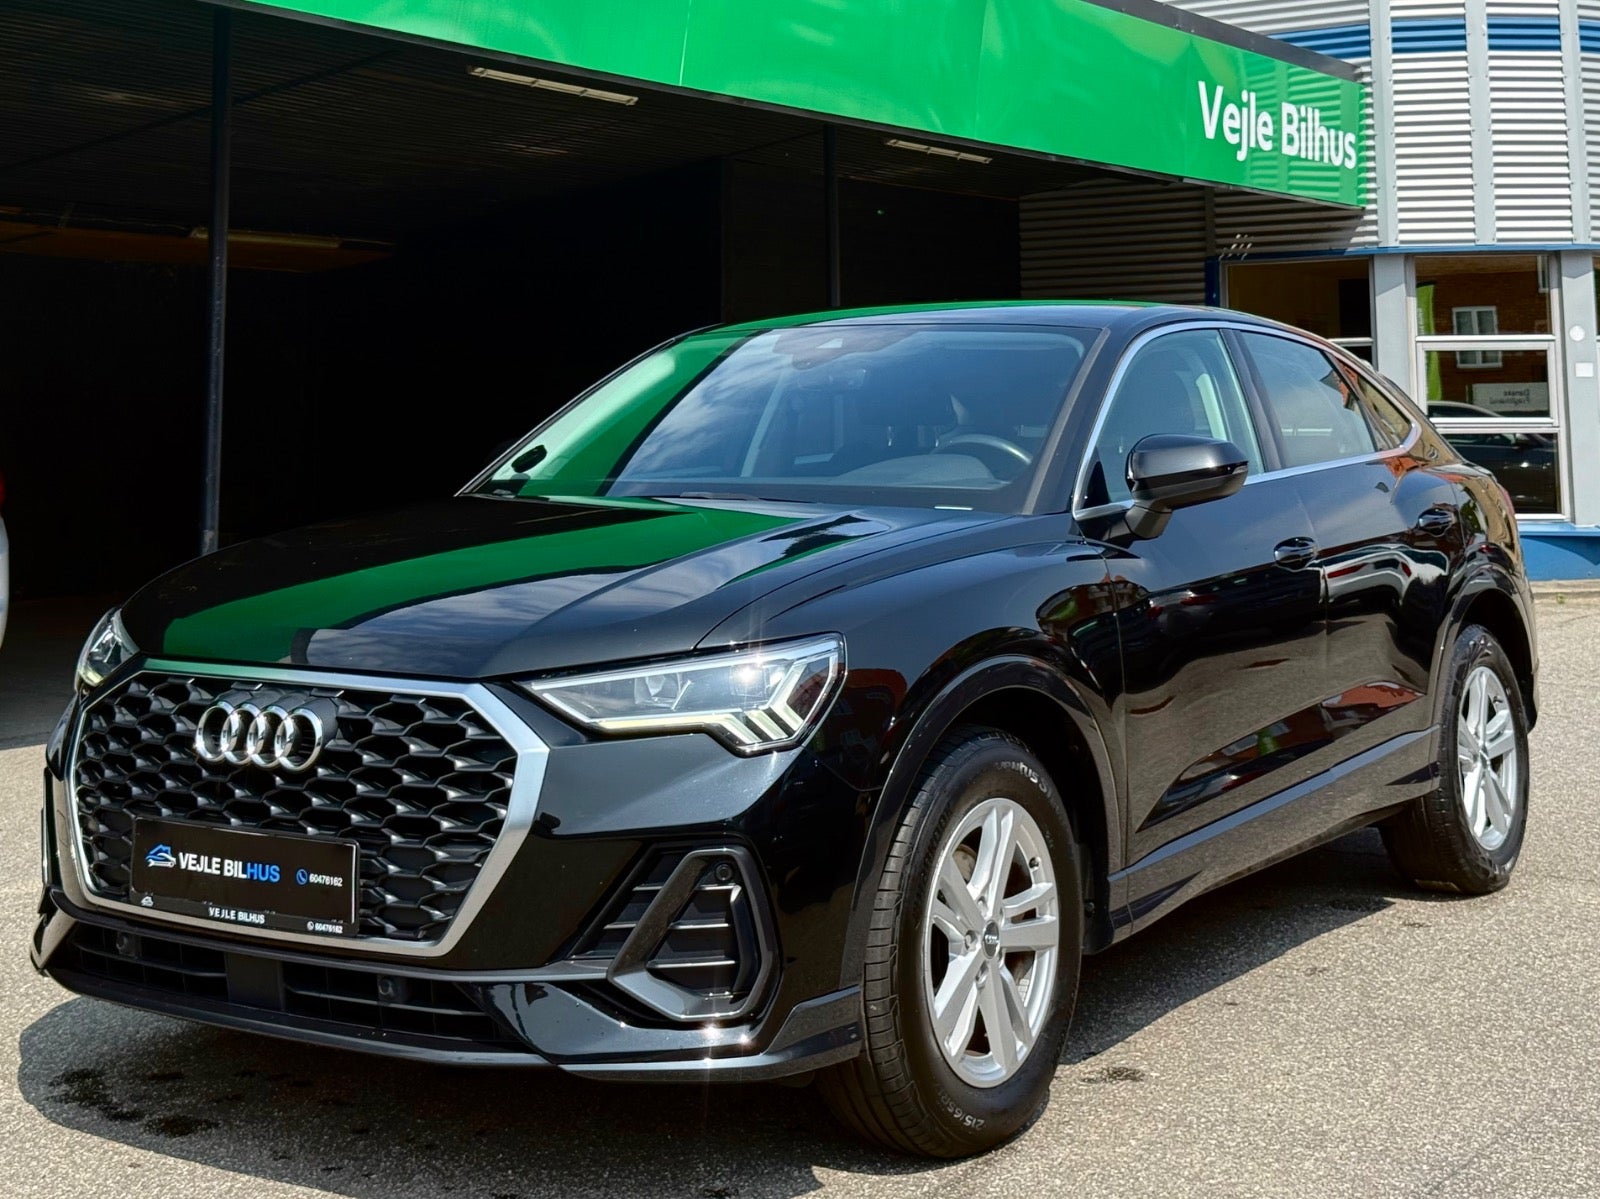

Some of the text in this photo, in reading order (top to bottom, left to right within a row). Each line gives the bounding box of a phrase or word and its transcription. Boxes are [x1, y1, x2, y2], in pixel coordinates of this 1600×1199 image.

[1197, 80, 1357, 170] Vejle Bilhus
[178, 851, 281, 883] VEJLE BILHUS
[208, 906, 265, 925] VEJLE BILHUS
